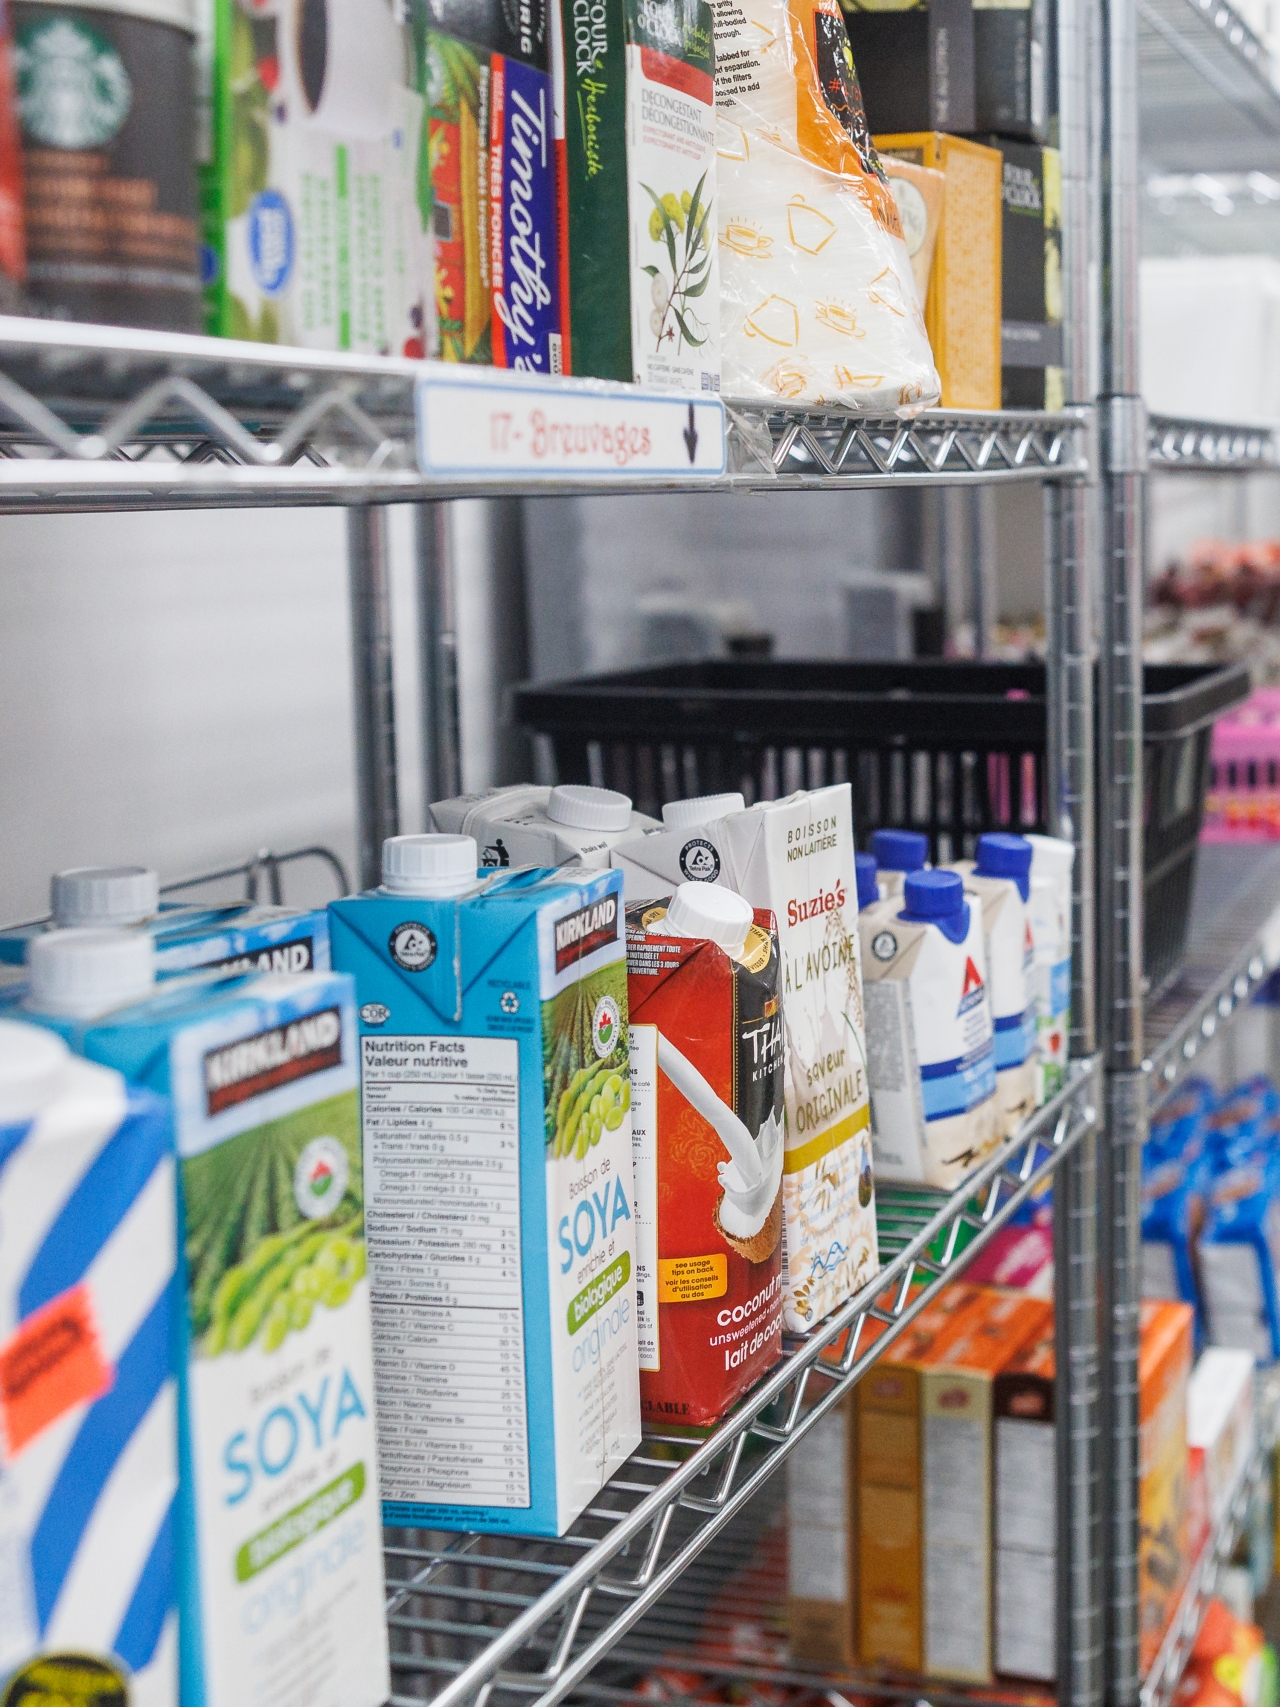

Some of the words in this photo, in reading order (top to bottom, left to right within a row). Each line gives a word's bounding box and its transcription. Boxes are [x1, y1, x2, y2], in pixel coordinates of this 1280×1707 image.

[717, 8, 743, 18] allowing
[713, 18, 746, 28] ull-bodied
[590, 0, 608, 68] OUR
[716, 52, 740, 62] tabbed
[740, 50, 750, 58] for
[724, 60, 760, 73] separation.
[721, 76, 732, 85] the
[733, 73, 752, 82] filters
[739, 85, 747, 93] to
[747, 82, 760, 92] add
[642, 88, 702, 123] DECONGESTANT
[642, 105, 714, 147] DÉCONGESTIONNANTE
[529, 409, 652, 466] Breuvages
[787, 815, 838, 844] BOISSON
[787, 844, 803, 863] NON
[804, 833, 838, 857] LAITIÈRE
[787, 878, 846, 928] Suzie's
[556, 899, 616, 951] KIRKLAND
[636, 944, 666, 953] RAPIDEMENT
[666, 945, 681, 953] TOUTE
[664, 961, 680, 969] JOURS
[785, 951, 792, 994] À
[795, 934, 855, 990] L'AVOINE
[365, 1041, 425, 1053] Nutrition
[429, 1041, 465, 1053] Facts
[365, 1055, 409, 1067] Valeur
[413, 1056, 469, 1068] nutritive
[806, 1049, 845, 1088] saveur
[796, 1068, 862, 1134] ORIGINALE
[365, 1105, 401, 1113] Calories
[408, 1105, 442, 1113] Calories
[365, 1119, 380, 1127] Fat
[386, 1119, 418, 1128] Lipides
[373, 1132, 412, 1140] Saturated
[381, 1142, 403, 1150] Trans
[410, 1142, 429, 1150] trans
[568, 1167, 598, 1200] Boisson
[600, 1157, 611, 1175] de
[367, 1210, 414, 1219] Cholesterol
[421, 1212, 468, 1221] Cholestérol
[367, 1224, 399, 1232] Sodium
[406, 1225, 437, 1233] Sodium
[558, 1172, 631, 1275] SOYA
[367, 1237, 410, 1246] Potassium
[417, 1239, 460, 1248] Potassium
[368, 1250, 423, 1260] Carbohydrate
[430, 1253, 466, 1262] Glucides
[577, 1249, 606, 1285] enrichie
[608, 1240, 615, 1257] et
[689, 1259, 711, 1269] usage
[671, 1268, 685, 1277] tips
[696, 1265, 714, 1274] back
[690, 1274, 719, 1284] conseils
[573, 1264, 623, 1323] biologique
[672, 1282, 713, 1293] d'utilisation
[369, 1291, 398, 1300] Protein
[717, 1275, 775, 1327] coconut
[709, 1308, 767, 1347] unsweetened
[407, 1335, 438, 1343] Calcium
[572, 1297, 630, 1372] originale
[724, 1341, 749, 1371] lait
[749, 1332, 763, 1355] de
[221, 1362, 367, 1507] SOYA
